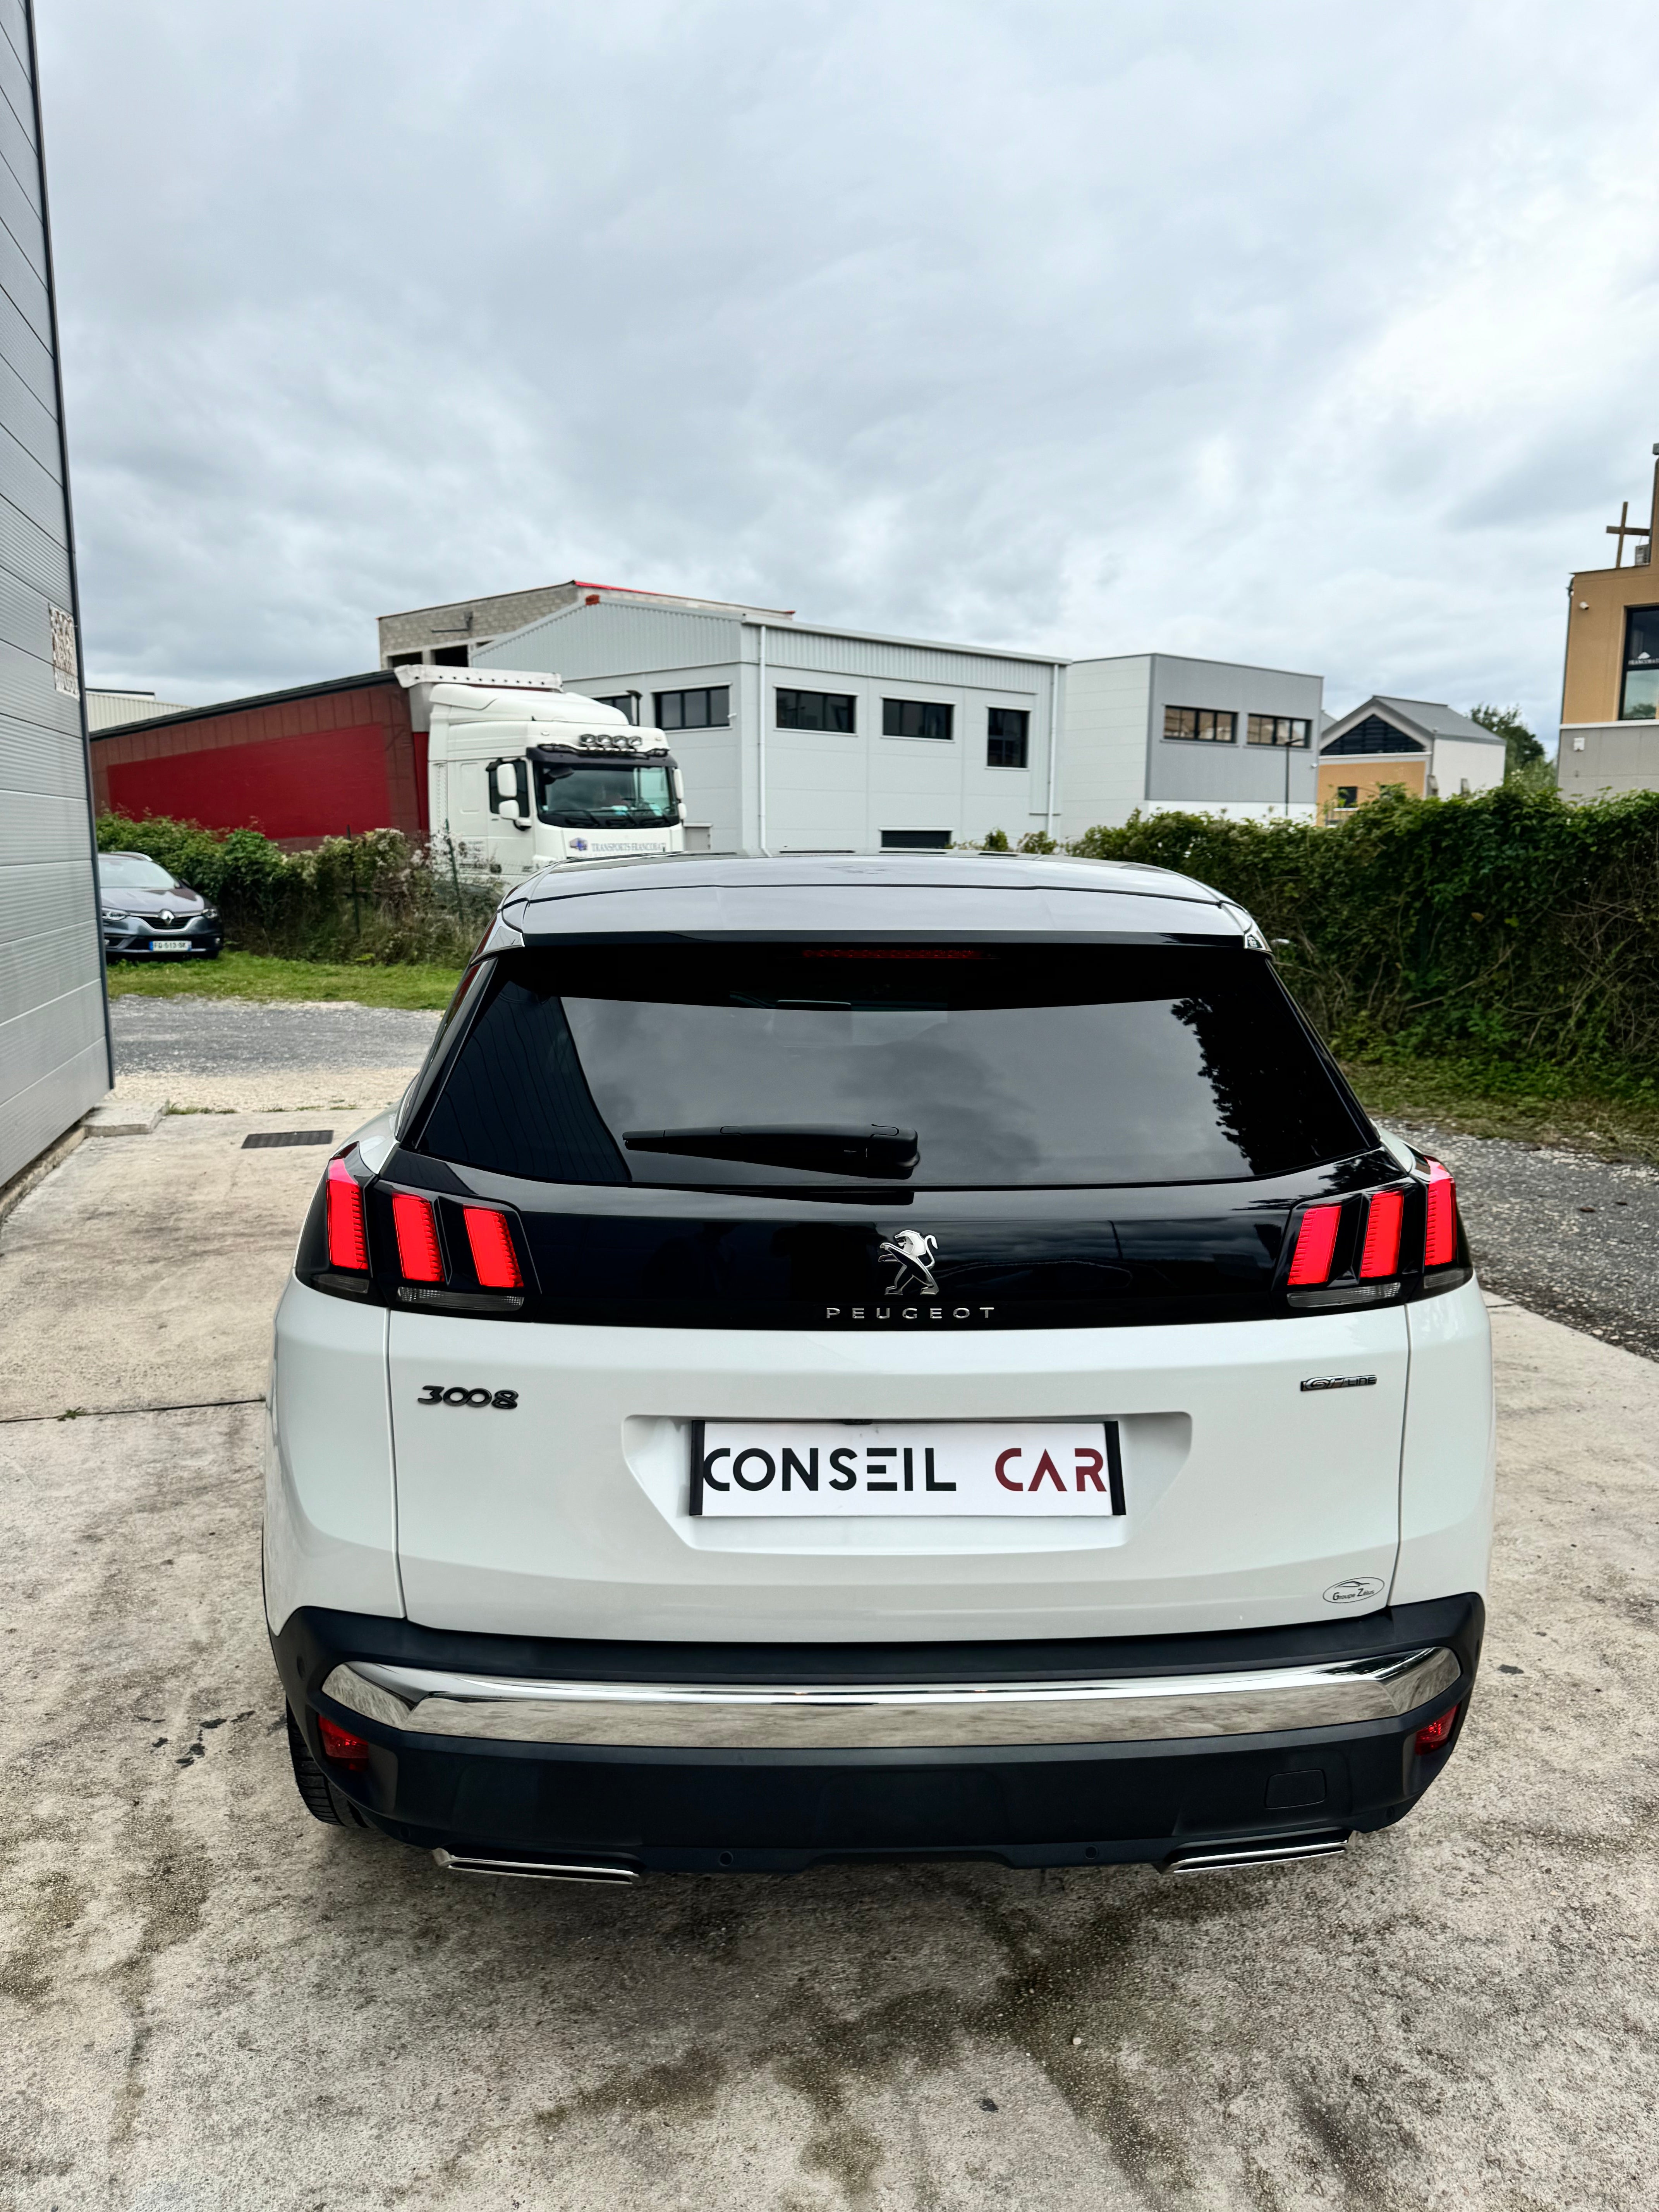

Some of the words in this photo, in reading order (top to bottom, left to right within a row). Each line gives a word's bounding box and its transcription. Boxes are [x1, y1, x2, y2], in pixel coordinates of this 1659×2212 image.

[826, 1307, 994, 1319] PEUGEOT
[1305, 1375, 1344, 1389] GT
[417, 1385, 519, 1409] 3008
[703, 1447, 957, 1492] CONSEIL
[995, 1447, 1107, 1492] CAR
[1333, 1592, 1356, 1601] Groupe
